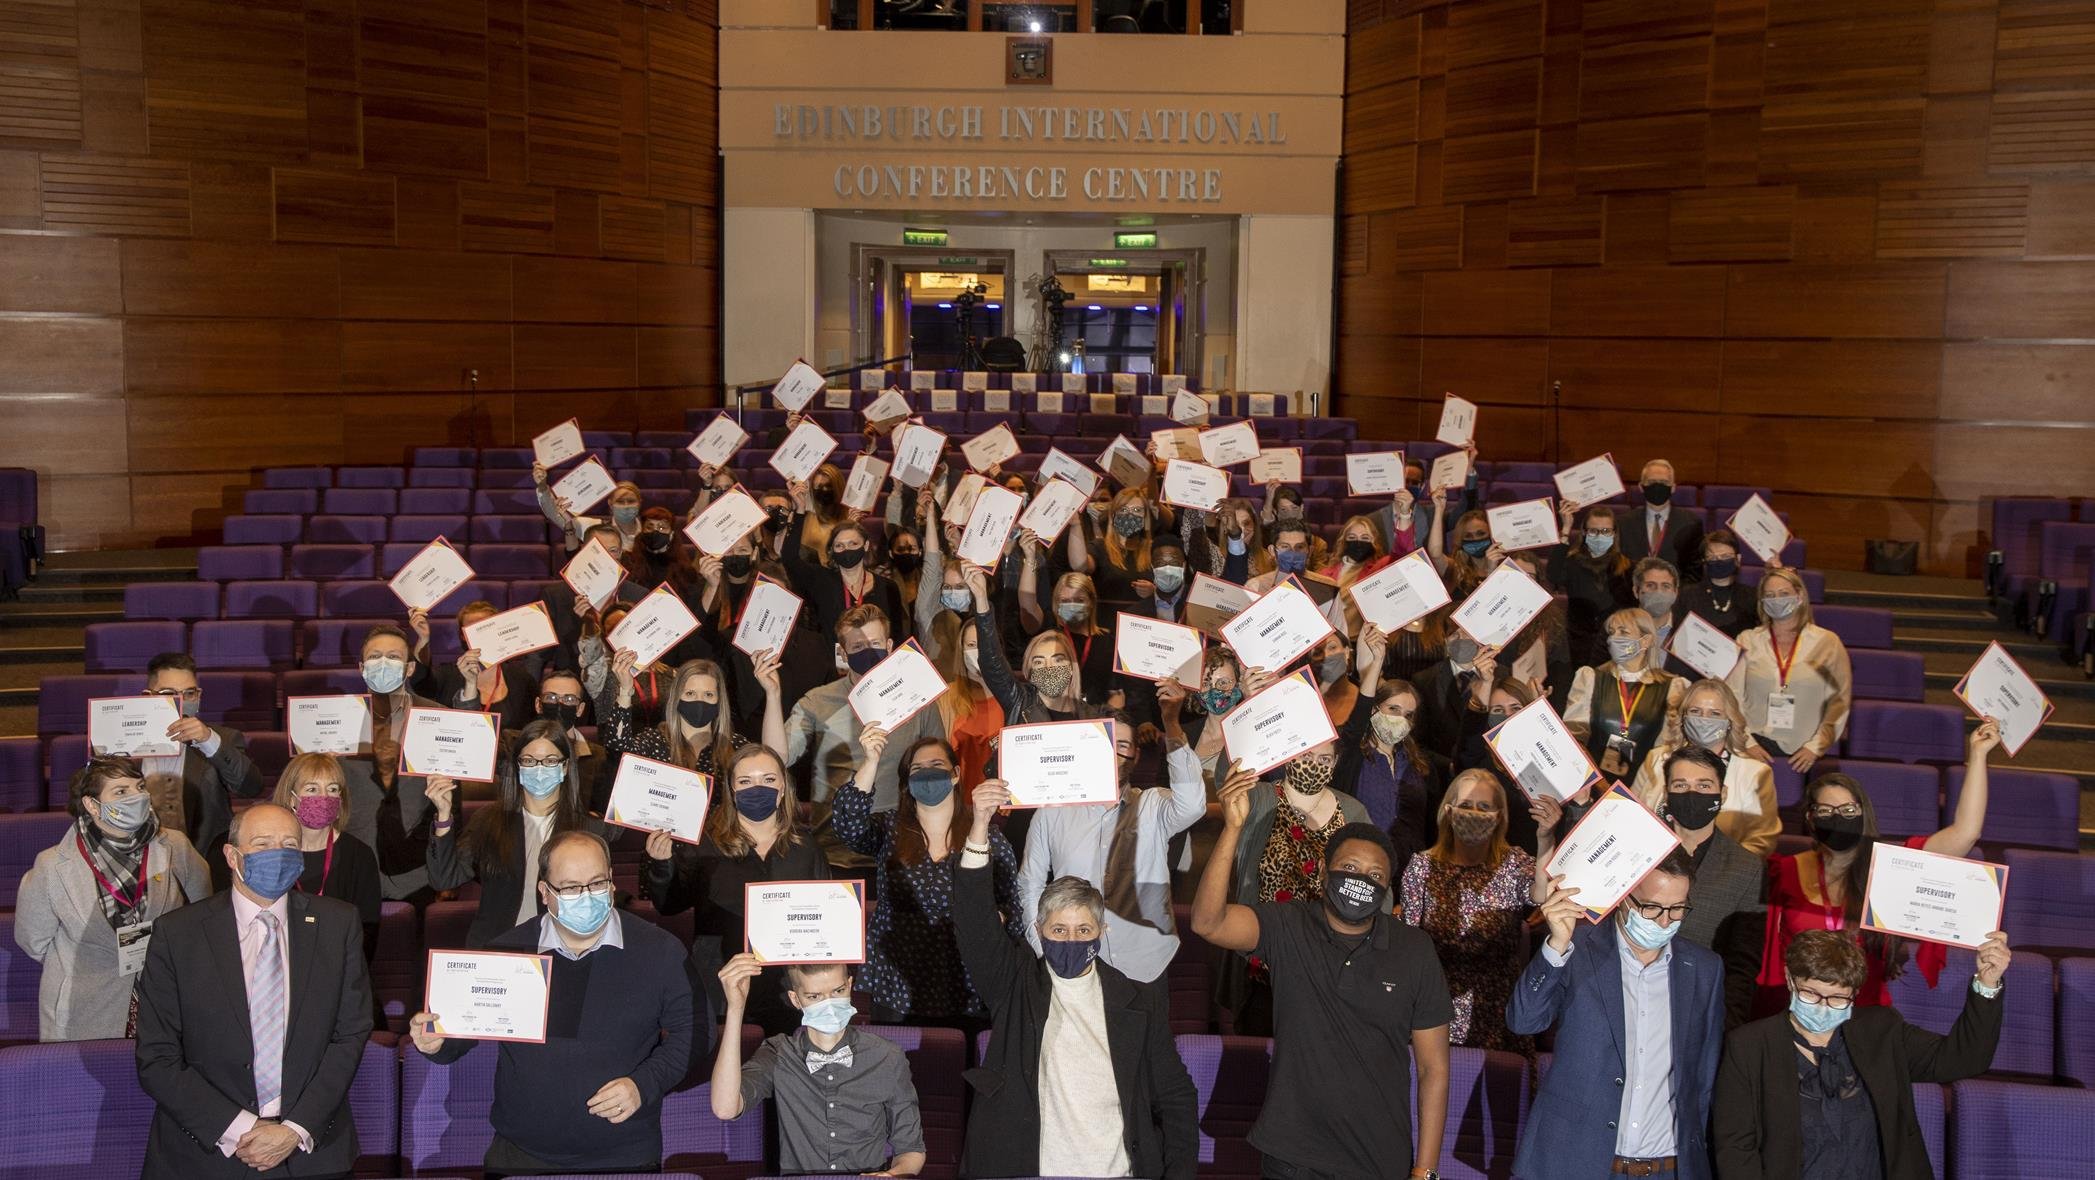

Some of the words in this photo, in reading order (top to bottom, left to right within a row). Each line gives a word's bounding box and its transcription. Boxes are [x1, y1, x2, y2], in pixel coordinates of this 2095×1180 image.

[774, 103, 983, 138] EDINBURGH
[1000, 105, 1287, 144] INTERNATIONAL
[834, 164, 1068, 198] CONFERENCE
[1083, 167, 1223, 200] CENTRE
[917, 236, 936, 244] EXIT
[1128, 239, 1146, 247] EXIT
[1362, 579, 1382, 592] CERTIFICATE
[1385, 583, 1410, 599] MANAGEMENT
[1488, 595, 1509, 616] MANAGEMENT
[637, 616, 659, 635] MANAGEMENT
[758, 608, 770, 632] MANAGEMENT
[1130, 622, 1152, 630] CERTIFICATE
[1234, 616, 1254, 633] CERTIFICATE
[1260, 617, 1285, 637] MANAGEMENT
[1148, 641, 1174, 652] SUPERVISORY
[856, 679, 874, 696] CERTIFICATE
[879, 678, 904, 697] MANAGEMENT
[1232, 708, 1252, 724] CERTIFICATE
[1254, 712, 1284, 731] SUPERVISORY
[1539, 713, 1558, 736] CERTIFICATE
[1015, 734, 1042, 742] CERTIFICATE
[1040, 755, 1075, 763] SUPERVISORY
[1536, 741, 1557, 768] MANAGEMENT
[634, 764, 657, 776] CERTIFICATE
[649, 788, 677, 801] MANAGEMENT
[1557, 843, 1578, 866] CERTIFICATE
[1588, 835, 1618, 864] MANAGEMENT
[1338, 886, 1361, 900] BETTER
[1359, 894, 1373, 902] BEER
[1343, 882, 1363, 893] STAND
[1916, 886, 1956, 900] SUPERVISORY
[447, 962, 477, 970] CERTIFICATE
[471, 986, 507, 995] SUPERVISORY
